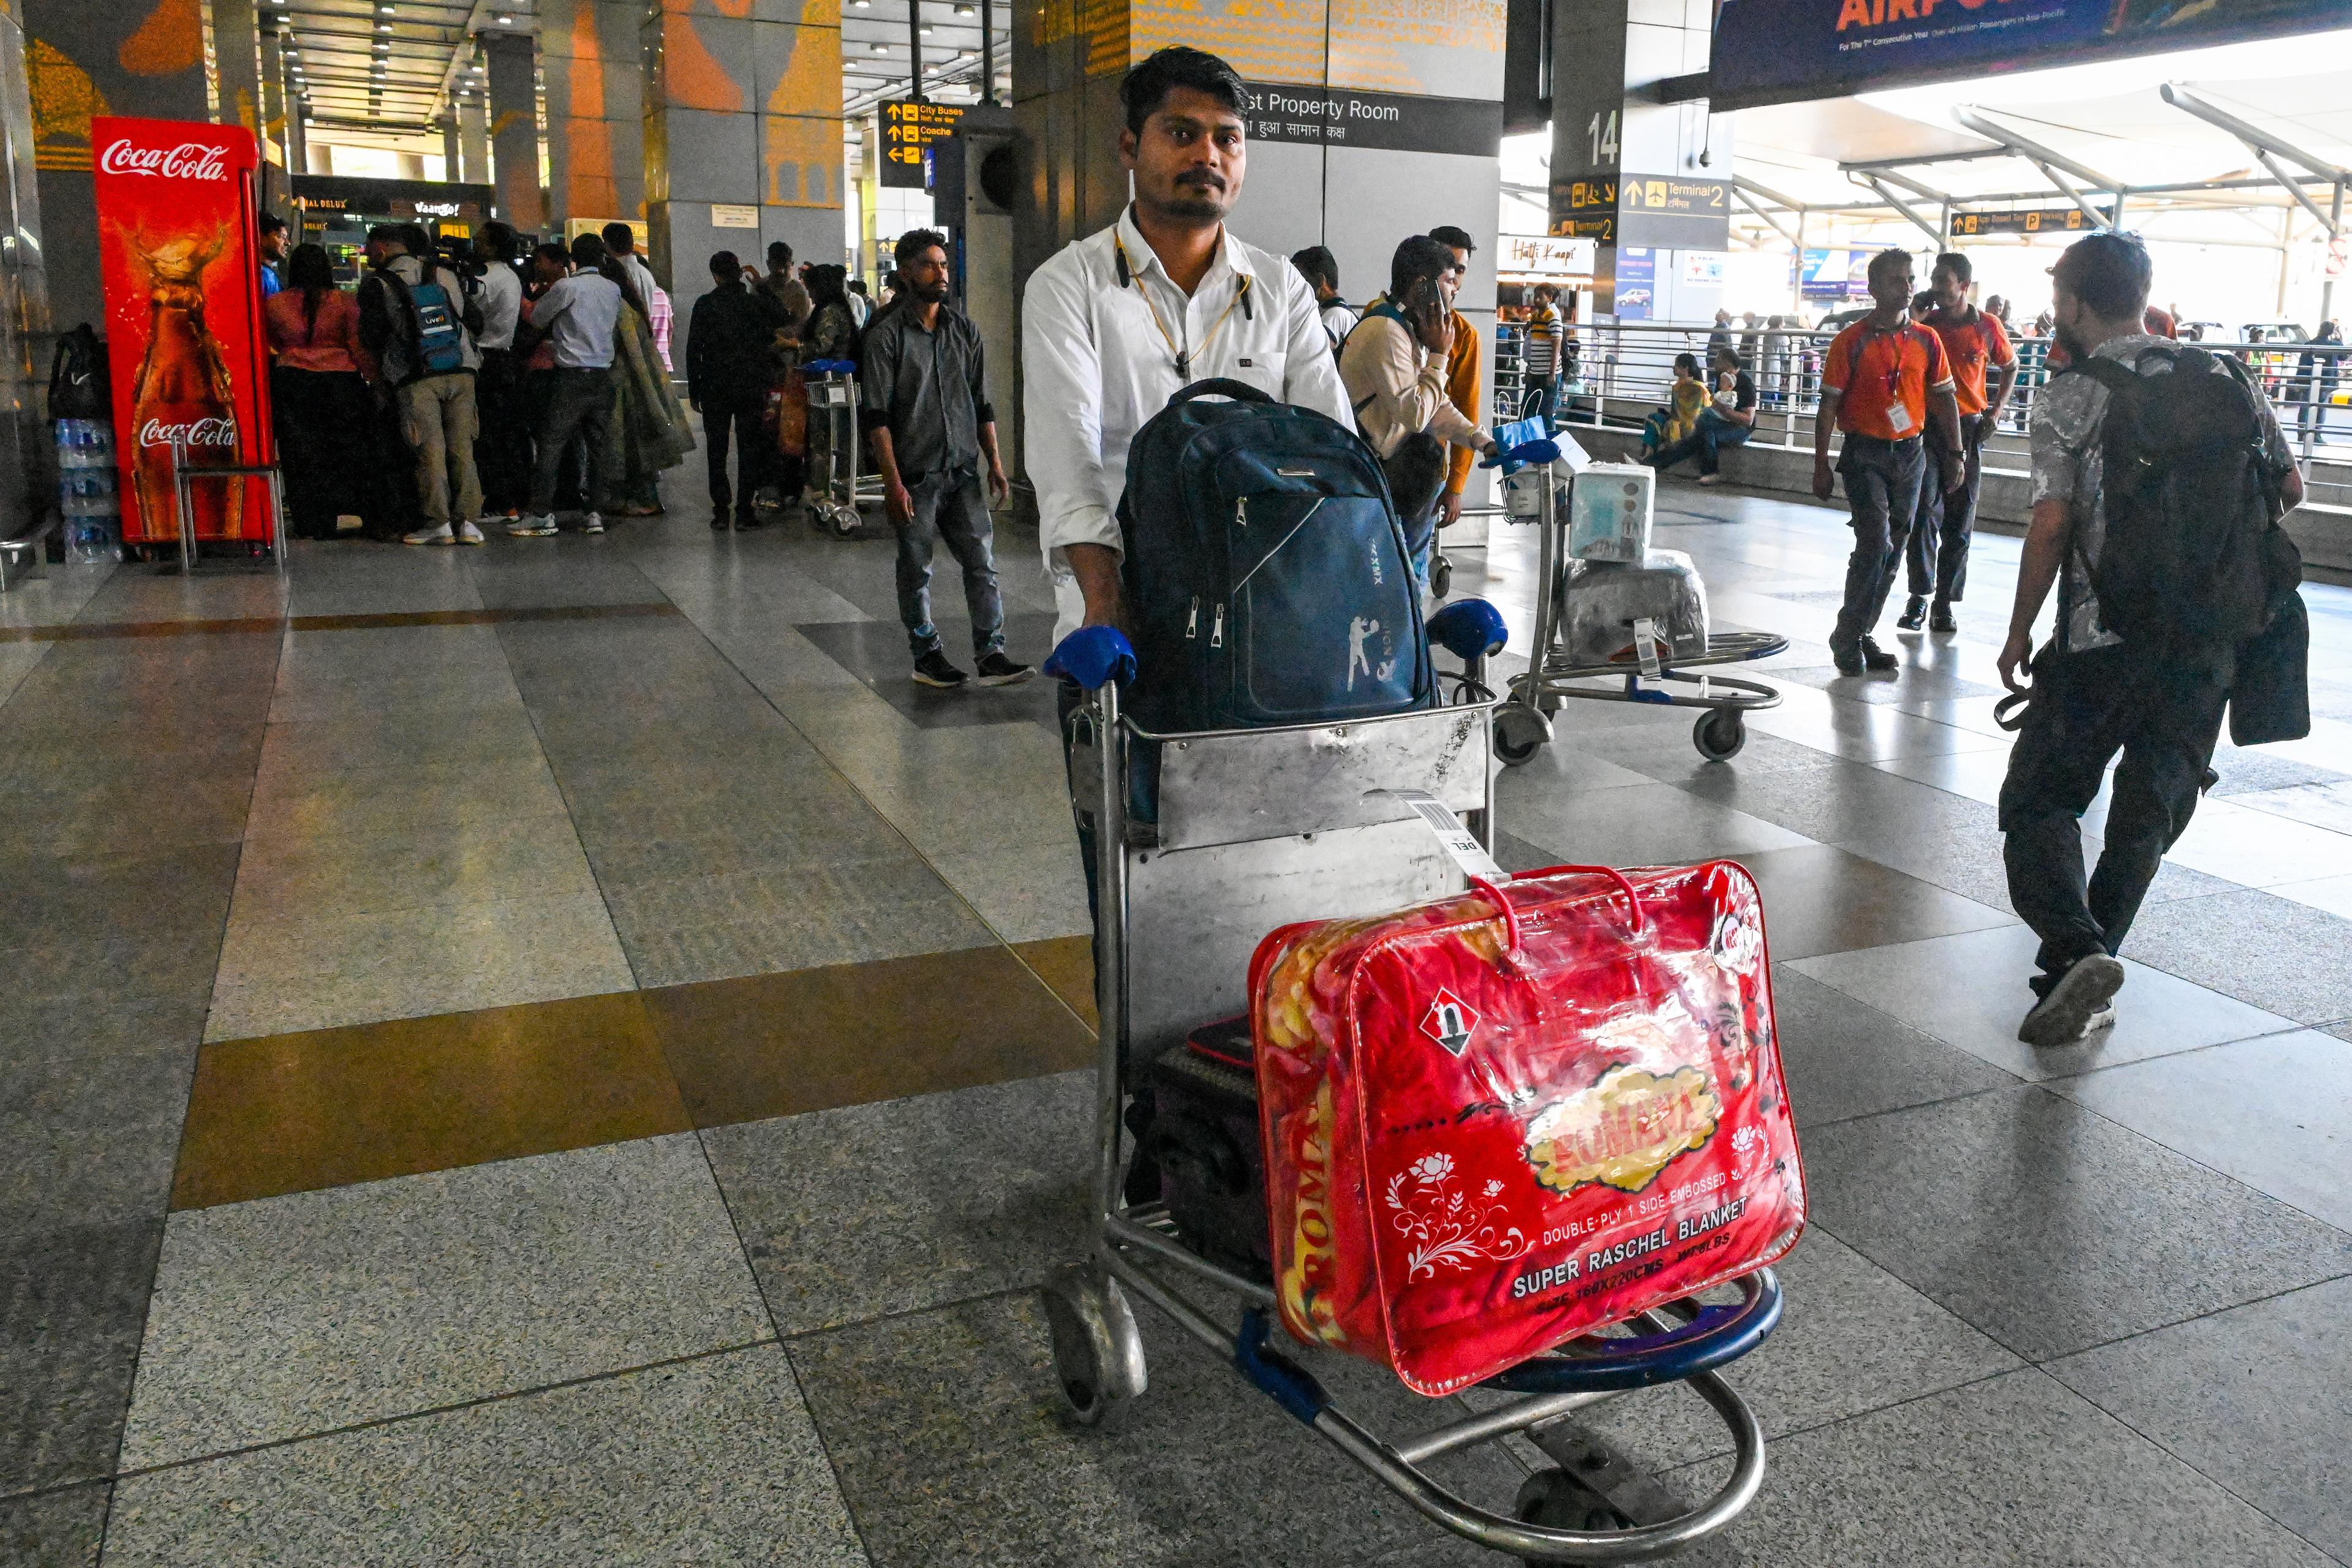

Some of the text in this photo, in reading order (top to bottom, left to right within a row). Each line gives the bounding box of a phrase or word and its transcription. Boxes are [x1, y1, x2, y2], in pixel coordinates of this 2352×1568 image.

[1839, 43, 1849, 51] For
[1872, 33, 1913, 45] Consecutive
[920, 105, 964, 116] City Buses
[1269, 93, 1344, 121] Property
[1349, 100, 1400, 121] Room
[1258, 121, 1280, 138] हुआ
[1286, 123, 1320, 137] सामान
[1326, 126, 1346, 139] कक्ष
[1588, 110, 1618, 166] 14
[101, 138, 230, 181] Coca-Cola
[1668, 182, 1724, 207] Terminal 2
[415, 201, 459, 217] Vaango!
[1602, 218, 1611, 239] 2
[1543, 244, 1576, 266] Kaapi
[1451, 842, 1478, 851] DEL
[1628, 1204, 1634, 1218] 1
[1639, 1194, 1666, 1215] SIDE
[1670, 1172, 1726, 1204] EMBOSSED
[1513, 1196, 1747, 1298] SUPER RASCHEL BLANKET
